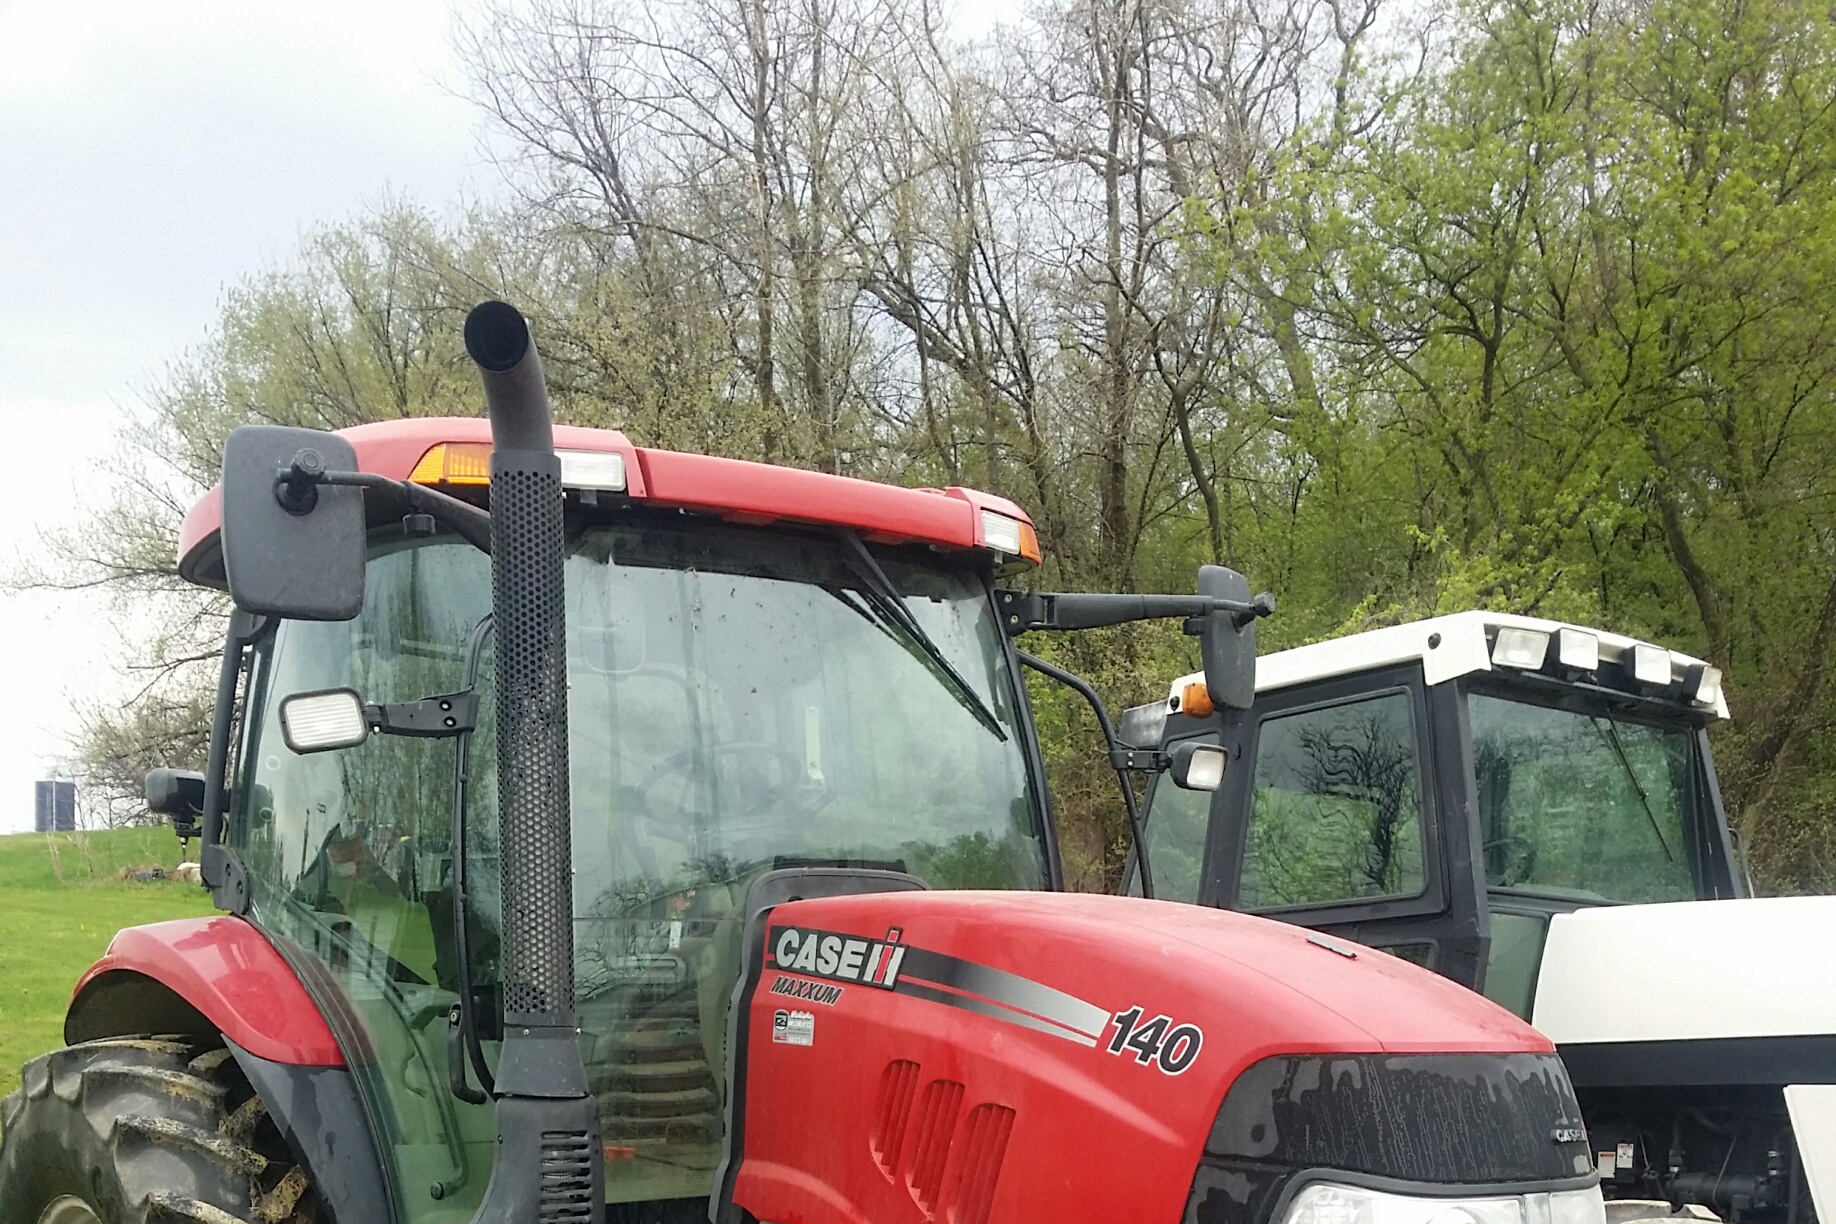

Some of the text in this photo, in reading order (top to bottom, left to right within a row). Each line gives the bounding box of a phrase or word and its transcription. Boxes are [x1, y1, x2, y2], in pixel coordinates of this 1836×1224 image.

[776, 929, 868, 979] CASE
[771, 976, 842, 1005] MAXXUM
[1106, 1005, 1204, 1077] 140
